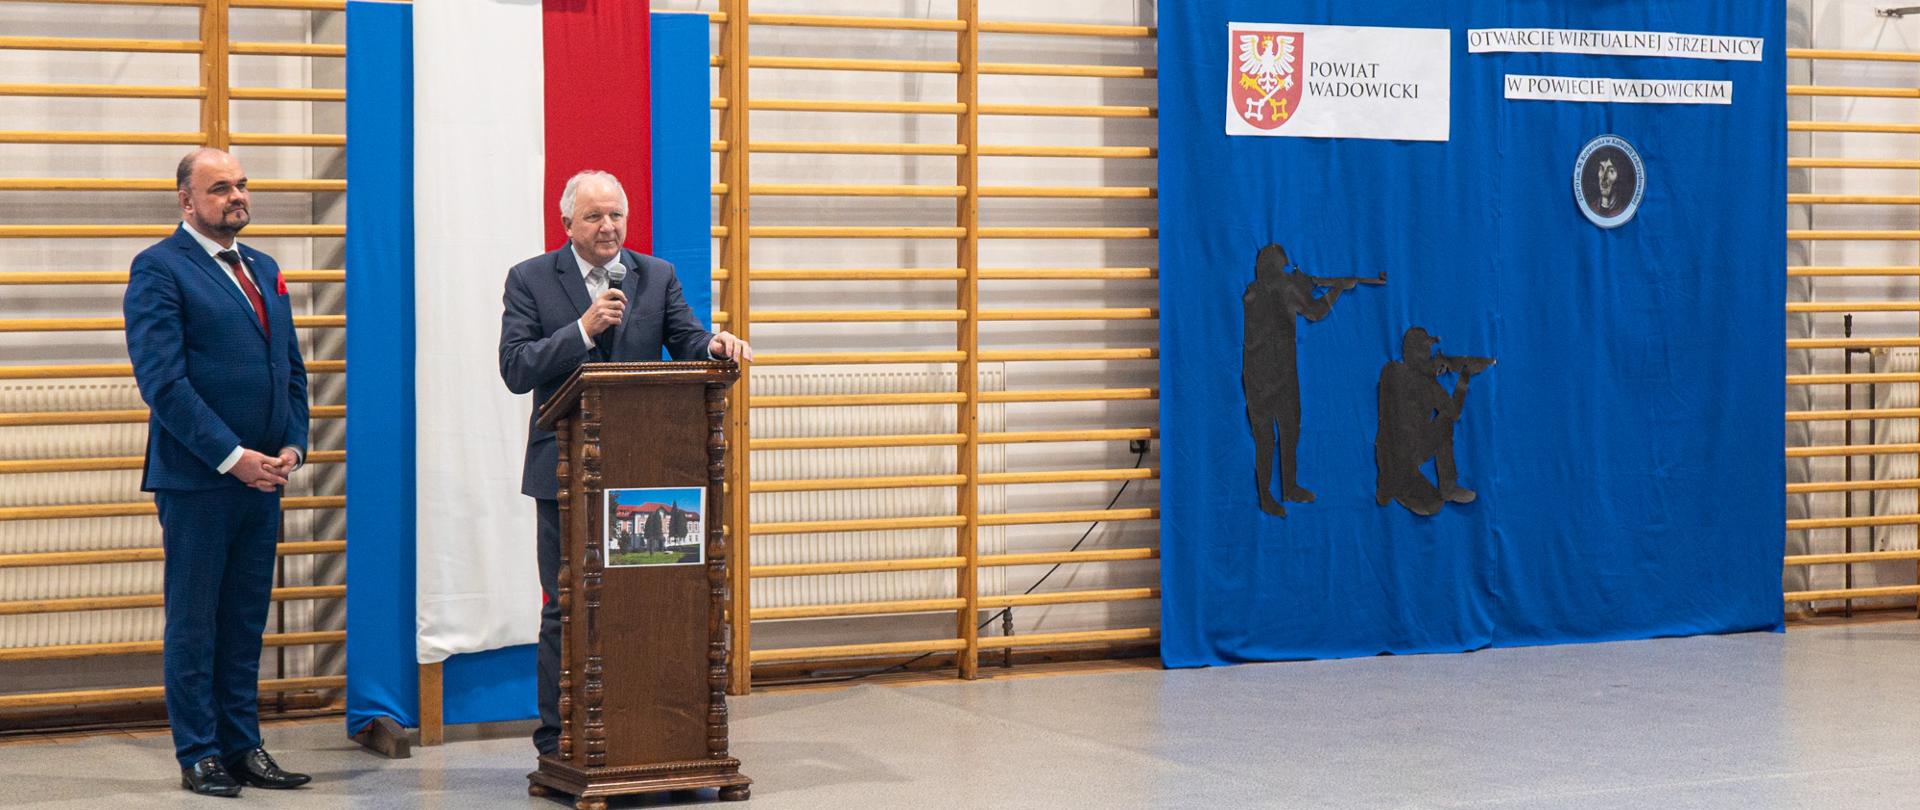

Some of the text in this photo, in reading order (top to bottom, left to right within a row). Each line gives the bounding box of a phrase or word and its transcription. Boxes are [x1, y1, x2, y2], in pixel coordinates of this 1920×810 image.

[1470, 31, 1760, 54] OTWARCIE WIRTUALNEJ STRZELNICY
[1310, 62, 1379, 78] POWIAT
[1309, 82, 1419, 99] WADOWICKI
[1507, 78, 1725, 98] W POWIECIE WADOWICKIM
